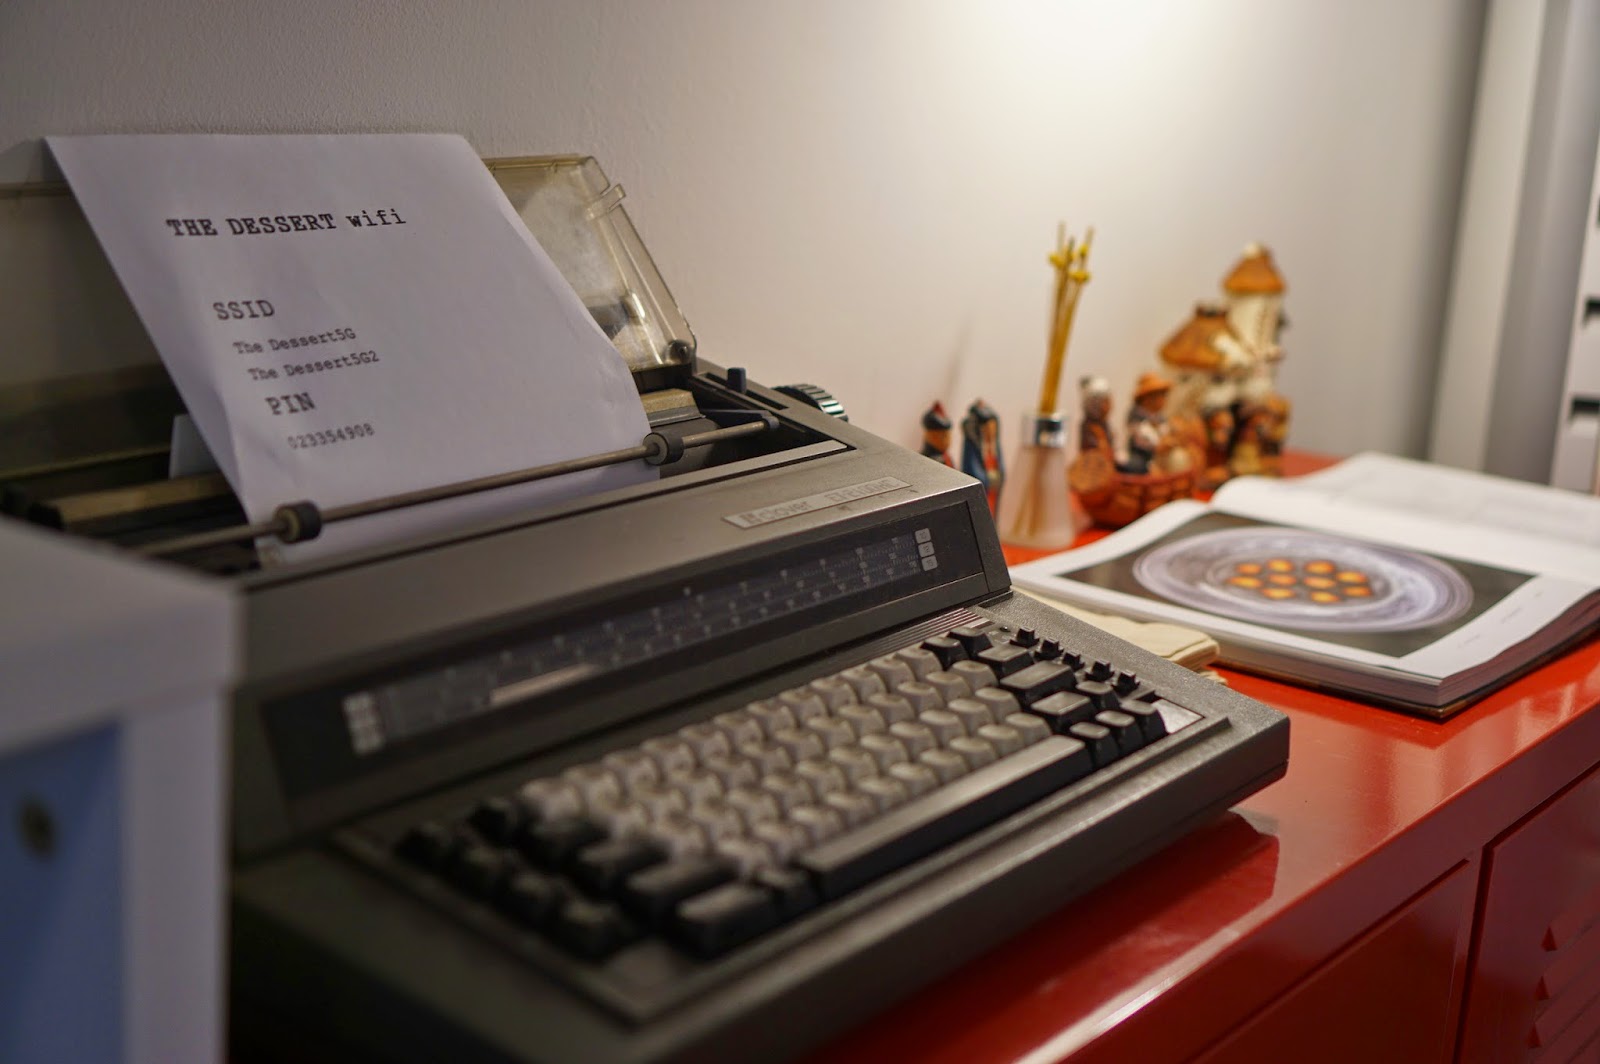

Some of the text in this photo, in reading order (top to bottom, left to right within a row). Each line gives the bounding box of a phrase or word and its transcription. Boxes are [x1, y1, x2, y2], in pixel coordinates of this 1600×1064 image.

[166, 208, 407, 236] THE DESSERT wifi
[212, 299, 276, 321] SSID
[232, 328, 357, 355] The Dessert5G
[247, 350, 380, 382] The Dessert5G2
[265, 392, 316, 416] PIN
